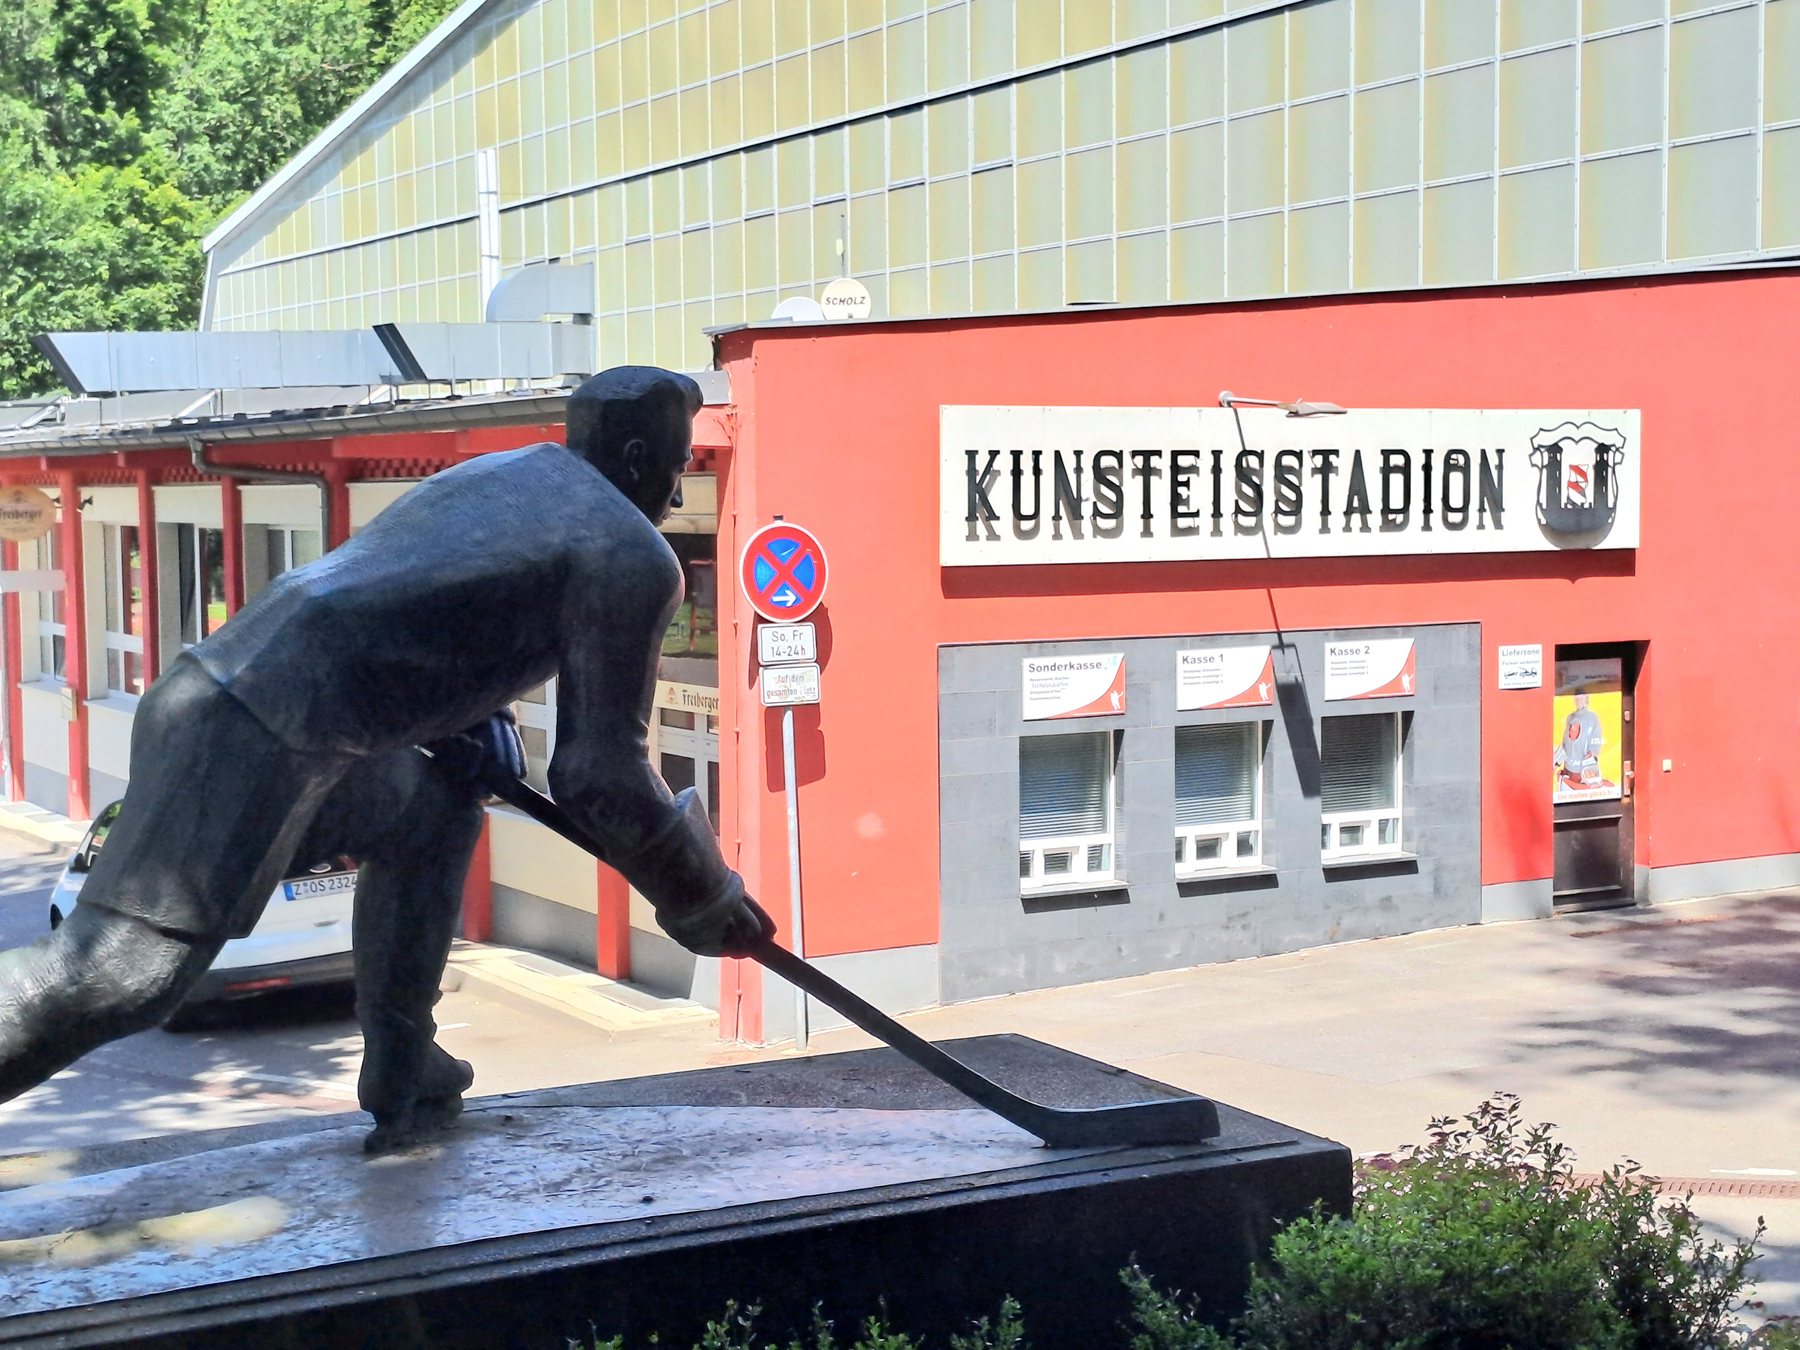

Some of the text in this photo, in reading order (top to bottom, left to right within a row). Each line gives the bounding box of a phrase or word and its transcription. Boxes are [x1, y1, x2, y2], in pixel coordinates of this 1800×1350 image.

[825, 296, 867, 306] SCHOLZ
[965, 447, 1507, 524] KUNSTEISSTADION
[792, 629, 804, 641] Fr
[1330, 645, 1370, 656] Kasse 2
[1501, 649, 1540, 657] Lieferzone
[1182, 653, 1224, 665] Kasse 1
[1028, 661, 1103, 673] Sonderkasse
[682, 689, 719, 712] Freiberger
[293, 883, 302, 896] Z
[309, 879, 326, 893] OS
